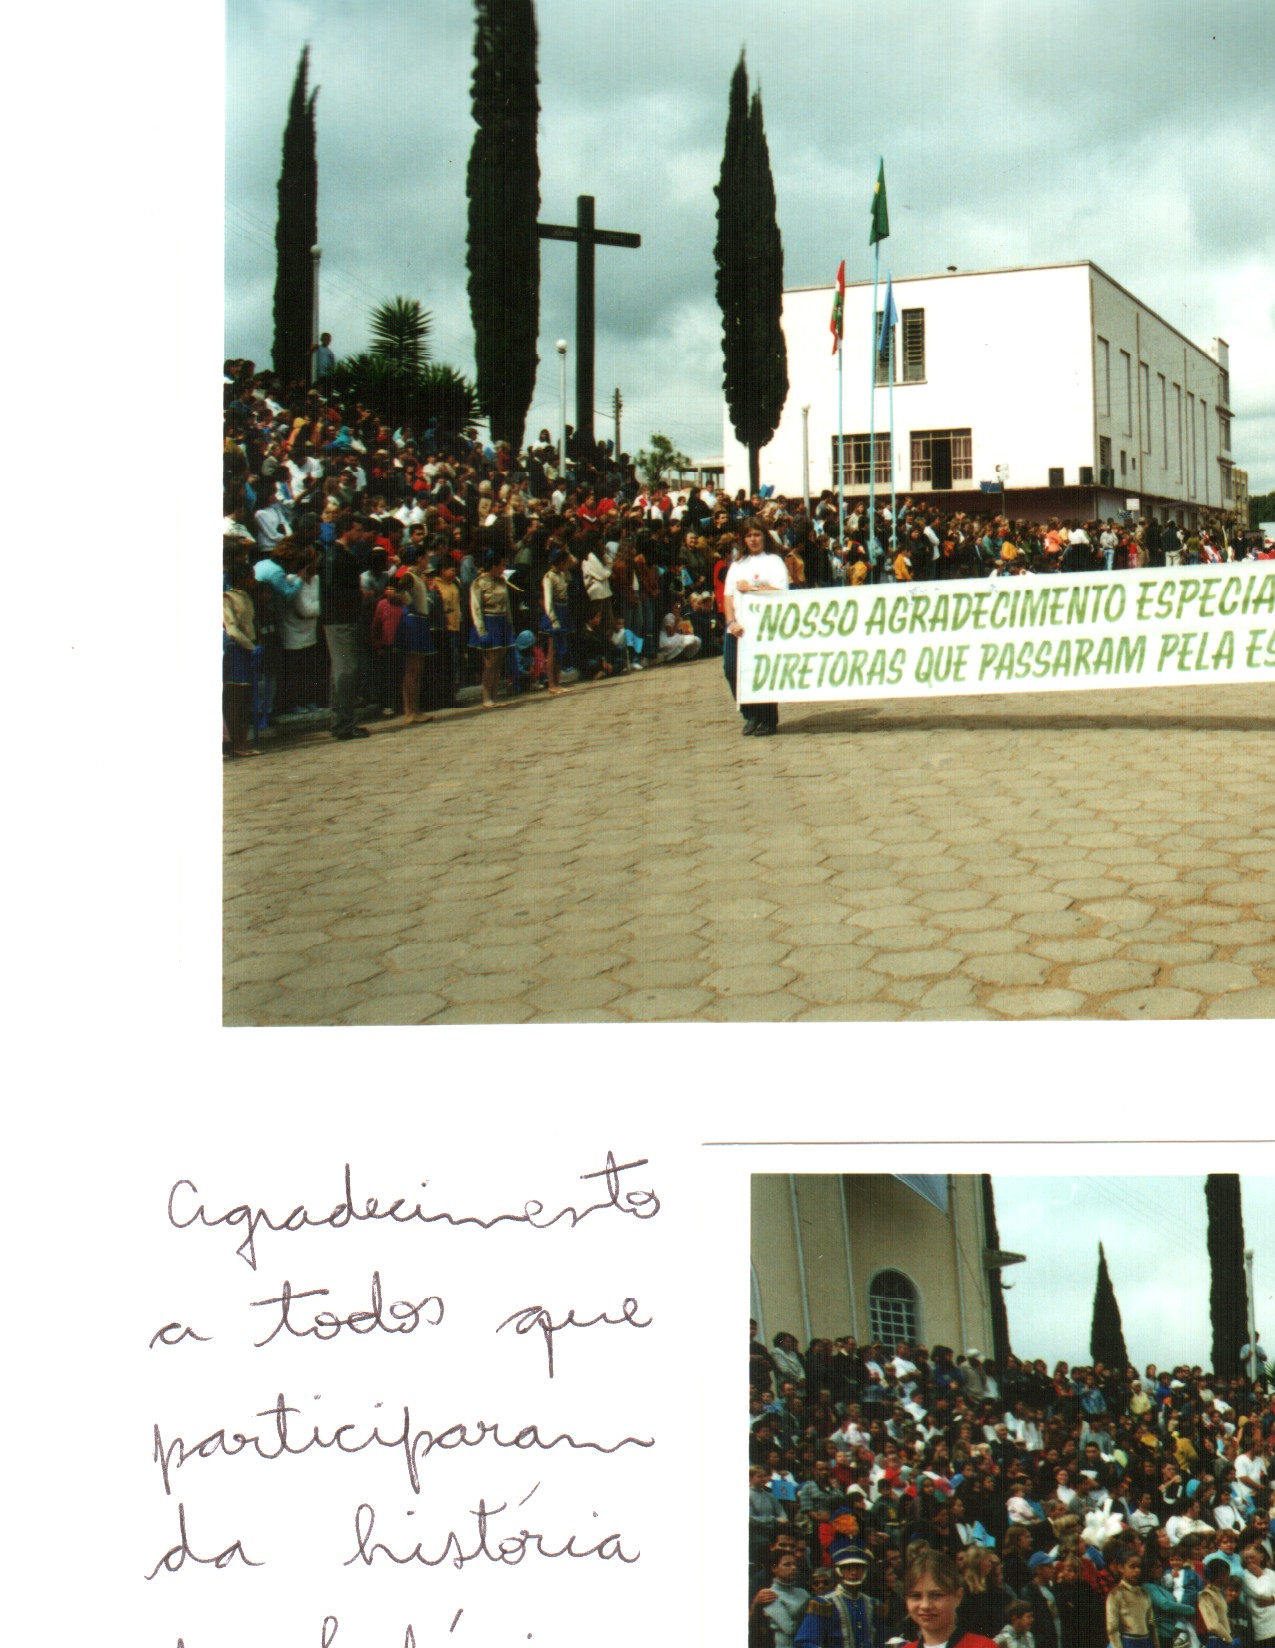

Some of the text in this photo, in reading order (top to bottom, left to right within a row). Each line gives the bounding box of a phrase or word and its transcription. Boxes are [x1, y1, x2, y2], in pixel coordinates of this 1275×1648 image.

[748, 600, 860, 642] "NOSSO
[864, 582, 1127, 637] AGRADECIMENTO
[751, 648, 906, 692] DIRETORAS
[914, 644, 971, 688] QUE
[978, 635, 1147, 682] PASSARAM
[1157, 630, 1234, 673] PELA
[168, 1151, 660, 1271] Agradecimento
[149, 1271, 653, 1378] a todos que
[154, 1393, 655, 1494] participaram
[144, 1481, 640, 1580] da história
